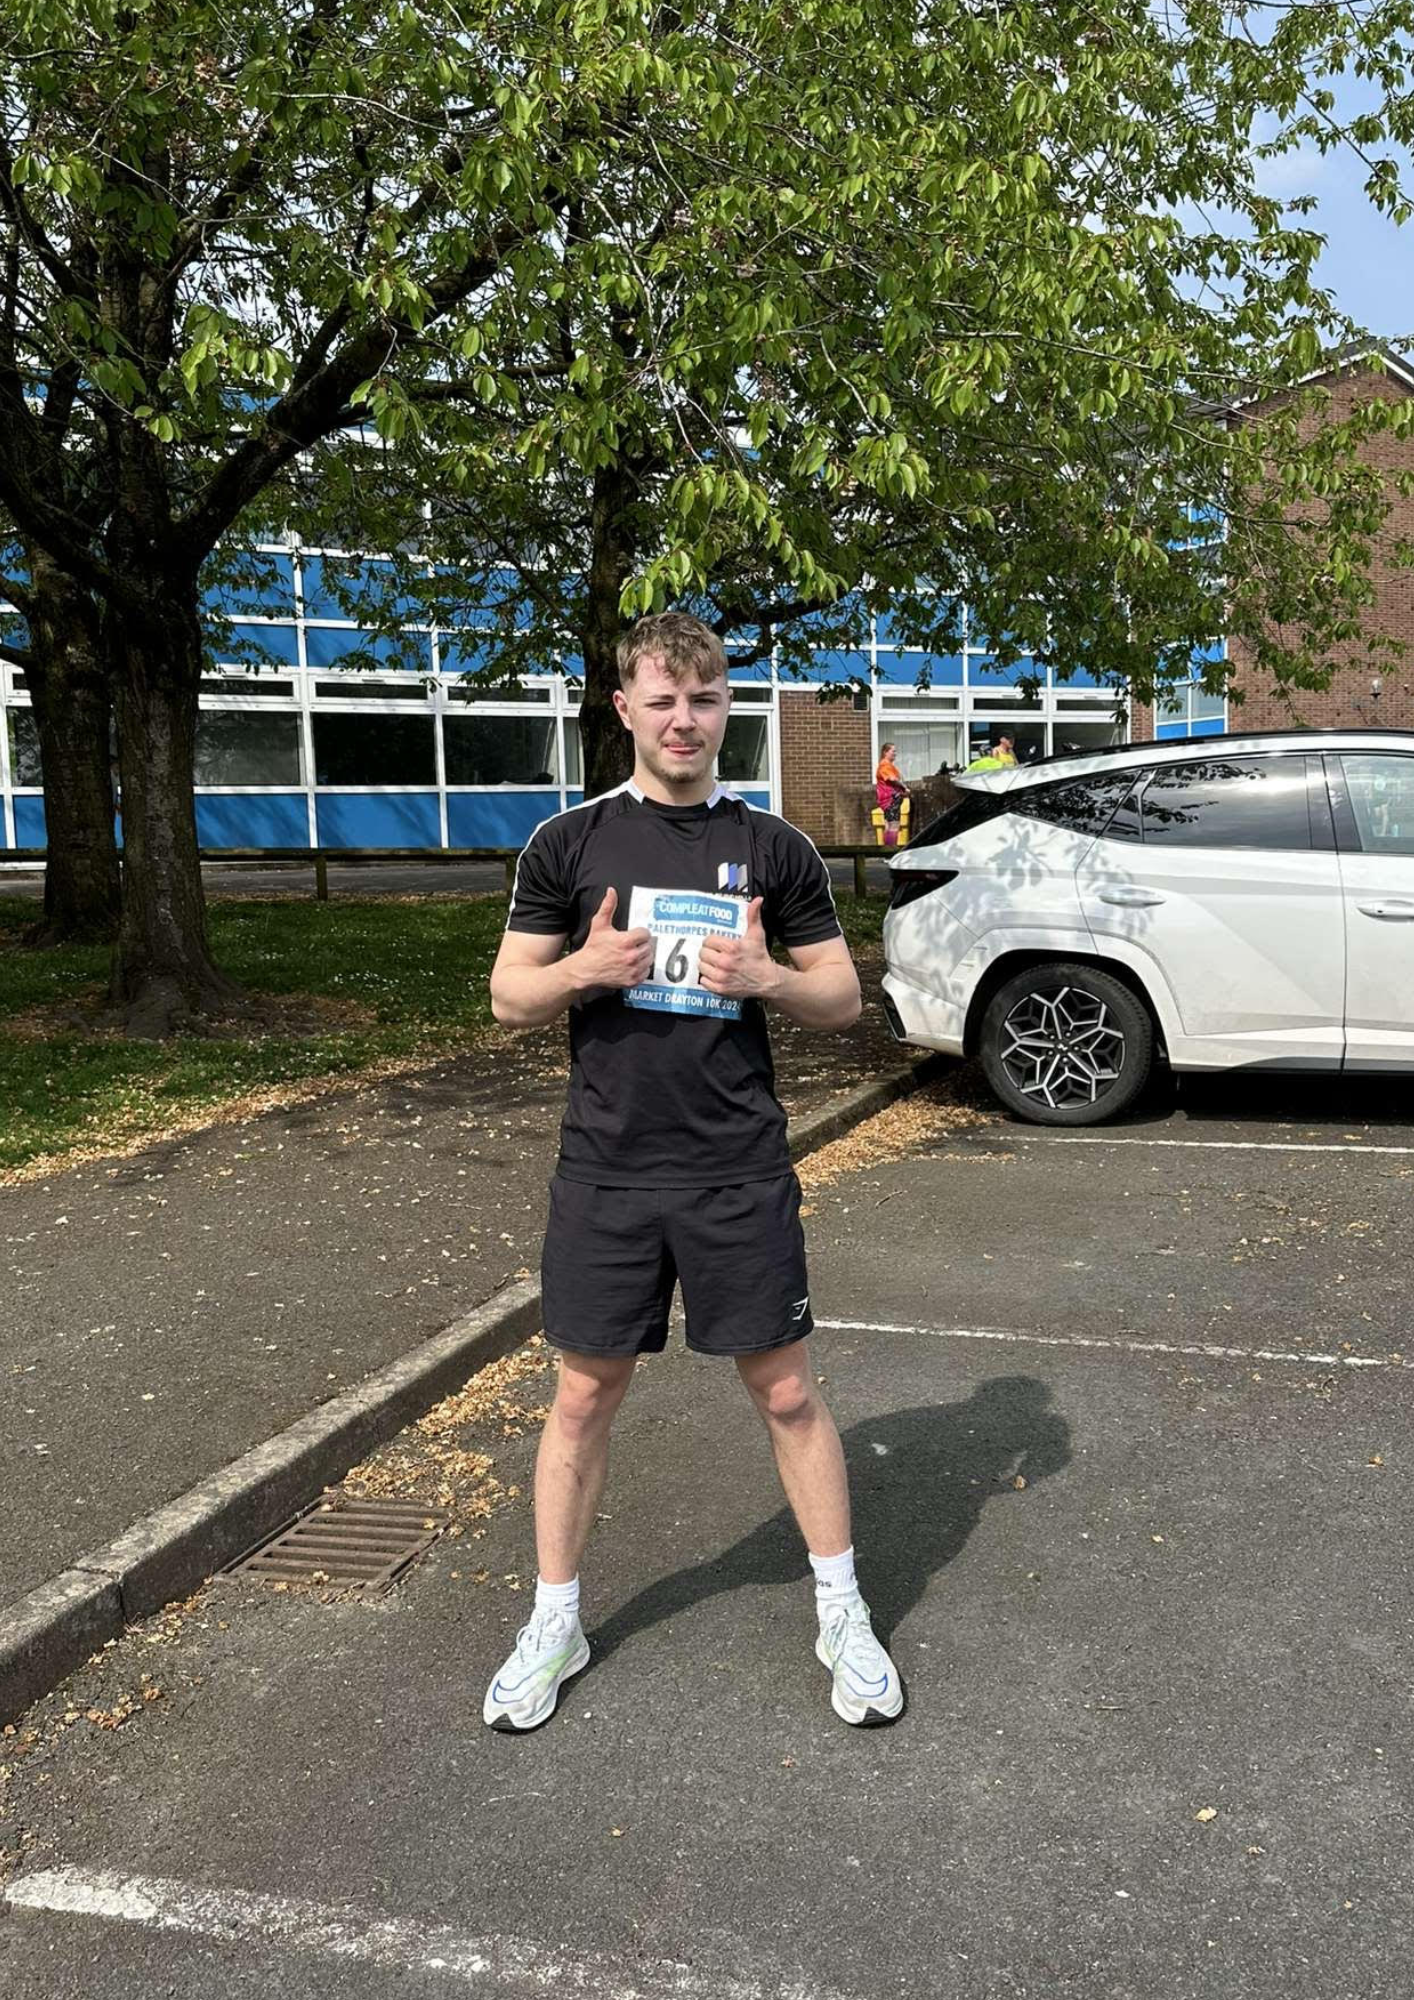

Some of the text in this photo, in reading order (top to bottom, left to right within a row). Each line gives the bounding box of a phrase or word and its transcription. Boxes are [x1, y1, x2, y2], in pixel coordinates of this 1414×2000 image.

[628, 989, 663, 1002] MARKET
[665, 993, 703, 1007] DRAYTON
[706, 999, 720, 1009] 10K
